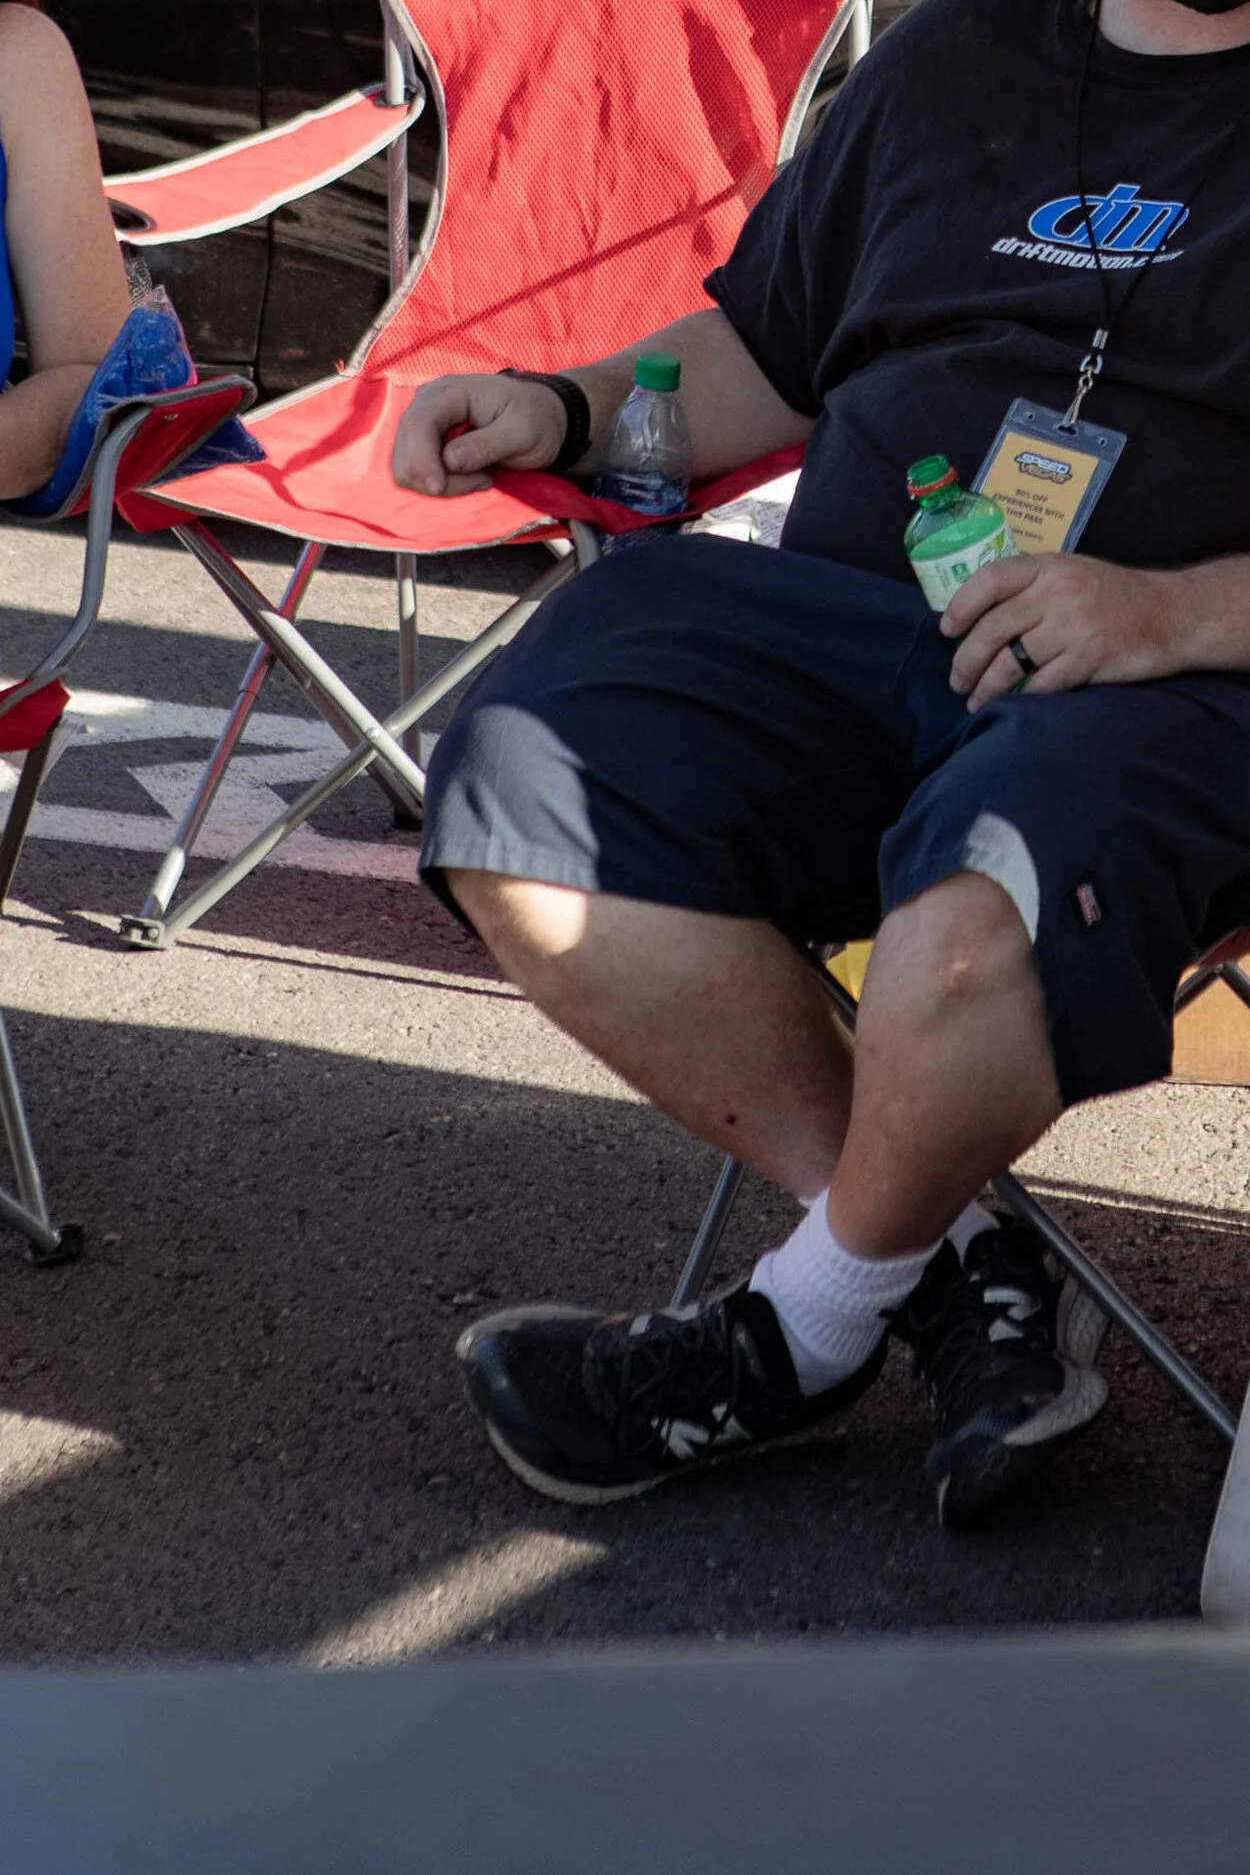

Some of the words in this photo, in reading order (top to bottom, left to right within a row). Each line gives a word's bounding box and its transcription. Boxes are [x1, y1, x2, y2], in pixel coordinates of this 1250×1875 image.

[1015, 453, 1071, 474] SPEED
[1020, 463, 1071, 484] VEGAS
[1006, 507, 1023, 519] THIS
[1044, 508, 1065, 520] WITH
